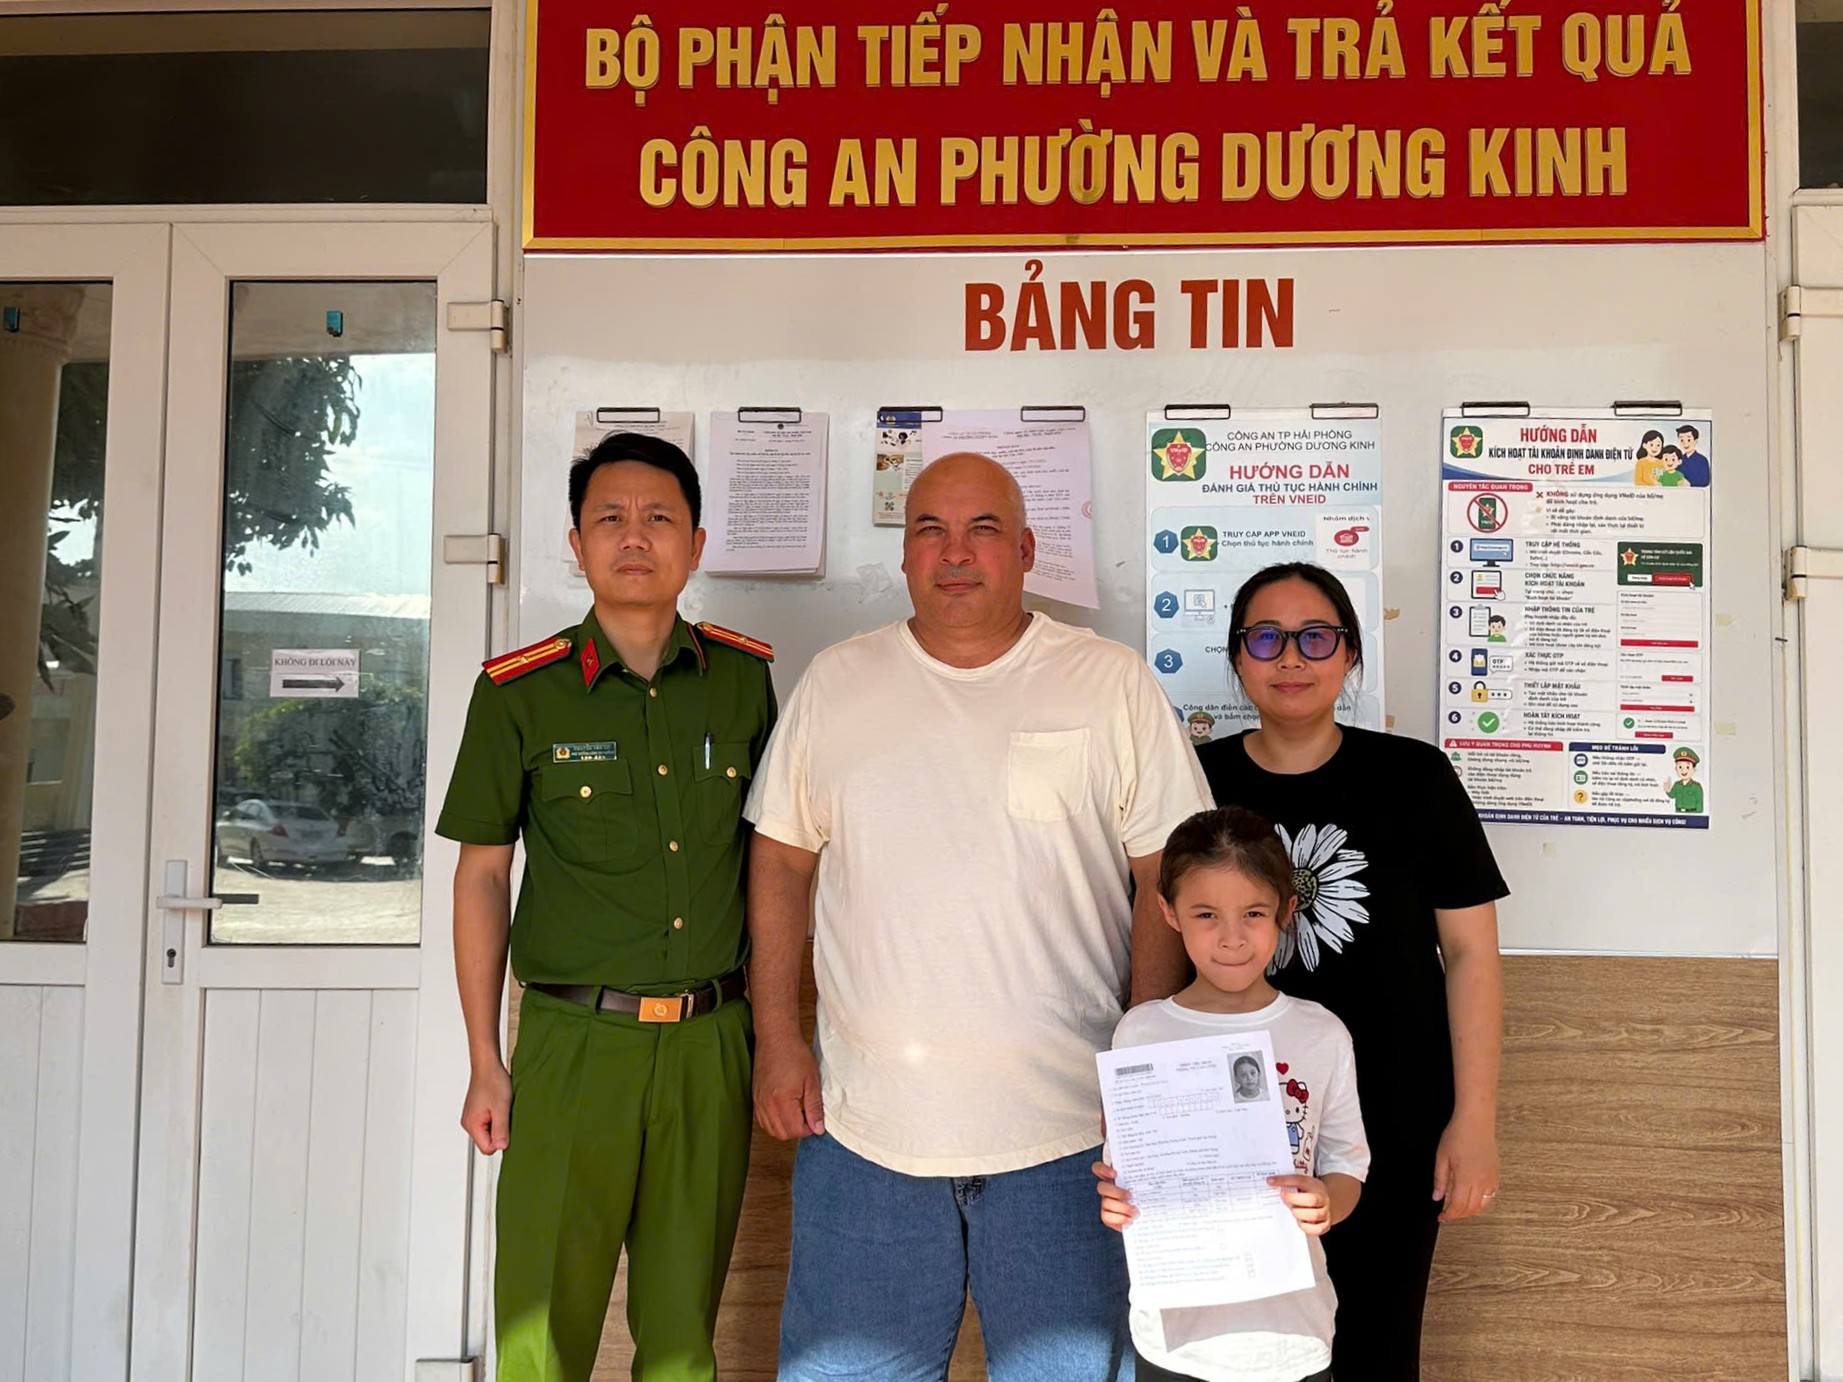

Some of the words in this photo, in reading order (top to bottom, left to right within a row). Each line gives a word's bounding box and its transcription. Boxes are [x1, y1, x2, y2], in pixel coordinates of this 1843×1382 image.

[585, 14, 661, 106] BỘ
[677, 13, 836, 104] PHẬN
[858, 3, 981, 87] TIẾP
[1002, 8, 1173, 98] NHẬN
[1192, 6, 1268, 83] VÀ
[1287, 0, 1406, 80] TRẢ
[1429, 0, 1541, 80] KẾT
[1562, 0, 1692, 83] QUẢ
[639, 125, 808, 208] CÔNG
[828, 137, 917, 207] AN
[940, 118, 1200, 206] PHƯỜNG
[1221, 123, 1447, 202] DƯƠNG
[1468, 127, 1628, 198] KINH
[964, 259, 1156, 352] BẢNG
[1181, 278, 1296, 349] TIN
[1227, 431, 1258, 441] CÔNG
[1260, 432, 1275, 441] AN
[1279, 431, 1291, 440] TP
[1294, 430, 1311, 440] HẢI
[1314, 430, 1353, 440] PHÒNG
[1520, 425, 1567, 442] HƯỚNG
[1570, 424, 1597, 443] DẪN
[1206, 442, 1236, 452] CÔNG
[1238, 443, 1252, 452] AN
[1255, 442, 1303, 451] PHƯỜNG
[1306, 441, 1347, 451] DƯƠNG
[1350, 441, 1375, 450] KINH
[1488, 446, 1506, 459] KÍCH
[1586, 448, 1604, 460] DANH
[1230, 462, 1303, 480] HƯỚNG
[1309, 460, 1350, 479] DẪN
[1528, 464, 1552, 474] CHO
[1554, 462, 1576, 475] TRẺ
[1578, 464, 1595, 475] EM
[1202, 483, 1233, 493] ĐÁNH
[1236, 482, 1256, 492] GIÁ
[1258, 482, 1280, 492] THỦ
[1284, 483, 1306, 494] TỤC
[1308, 481, 1340, 492] HÀNH
[1343, 482, 1378, 492] CHÍNH
[1252, 494, 1286, 504] TRÊN
[1288, 494, 1326, 504] VNEID
[1162, 534, 1169, 548] 1
[1454, 542, 1460, 550] 1
[1162, 598, 1172, 612] 2
[274, 656, 306, 666] KHÔNG
[1164, 654, 1174, 668] 3
